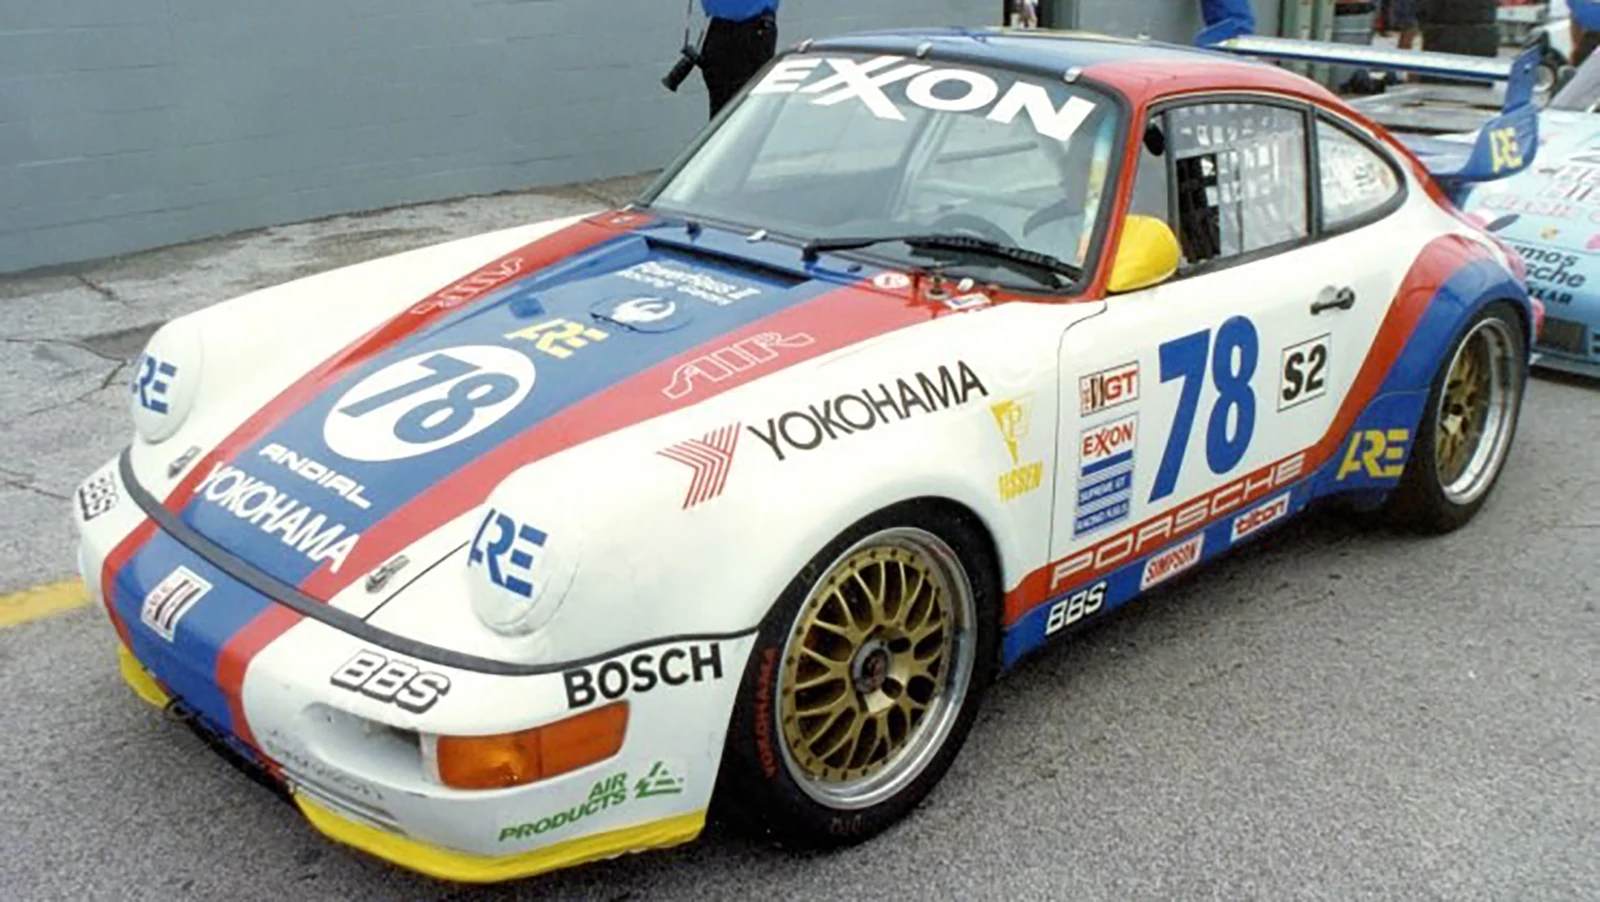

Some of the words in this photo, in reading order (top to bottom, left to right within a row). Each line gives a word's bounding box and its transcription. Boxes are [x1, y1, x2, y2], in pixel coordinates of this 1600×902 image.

[750, 55, 1096, 142] EXXON
[1514, 245, 1580, 267] mos
[1525, 262, 1586, 288] sche
[661, 332, 815, 399] AIR
[1105, 369, 1140, 401] GT
[1283, 344, 1328, 402] S2
[337, 353, 520, 444] 78
[747, 360, 989, 461] YOKOHAMA
[1148, 315, 1258, 504] 78
[1082, 421, 1134, 457] EXXON
[1336, 428, 1409, 480] ARE
[258, 442, 372, 510] ANDIAL
[194, 461, 361, 574] YOKOHAMA
[1050, 453, 1306, 589] PORSCHE
[1145, 541, 1199, 582] SIMPSON
[1046, 580, 1108, 636] BBS
[330, 648, 450, 714] BBS
[563, 642, 723, 709] BOSCH
[498, 789, 628, 842] PRODUCTS
[588, 771, 629, 802] AIR
